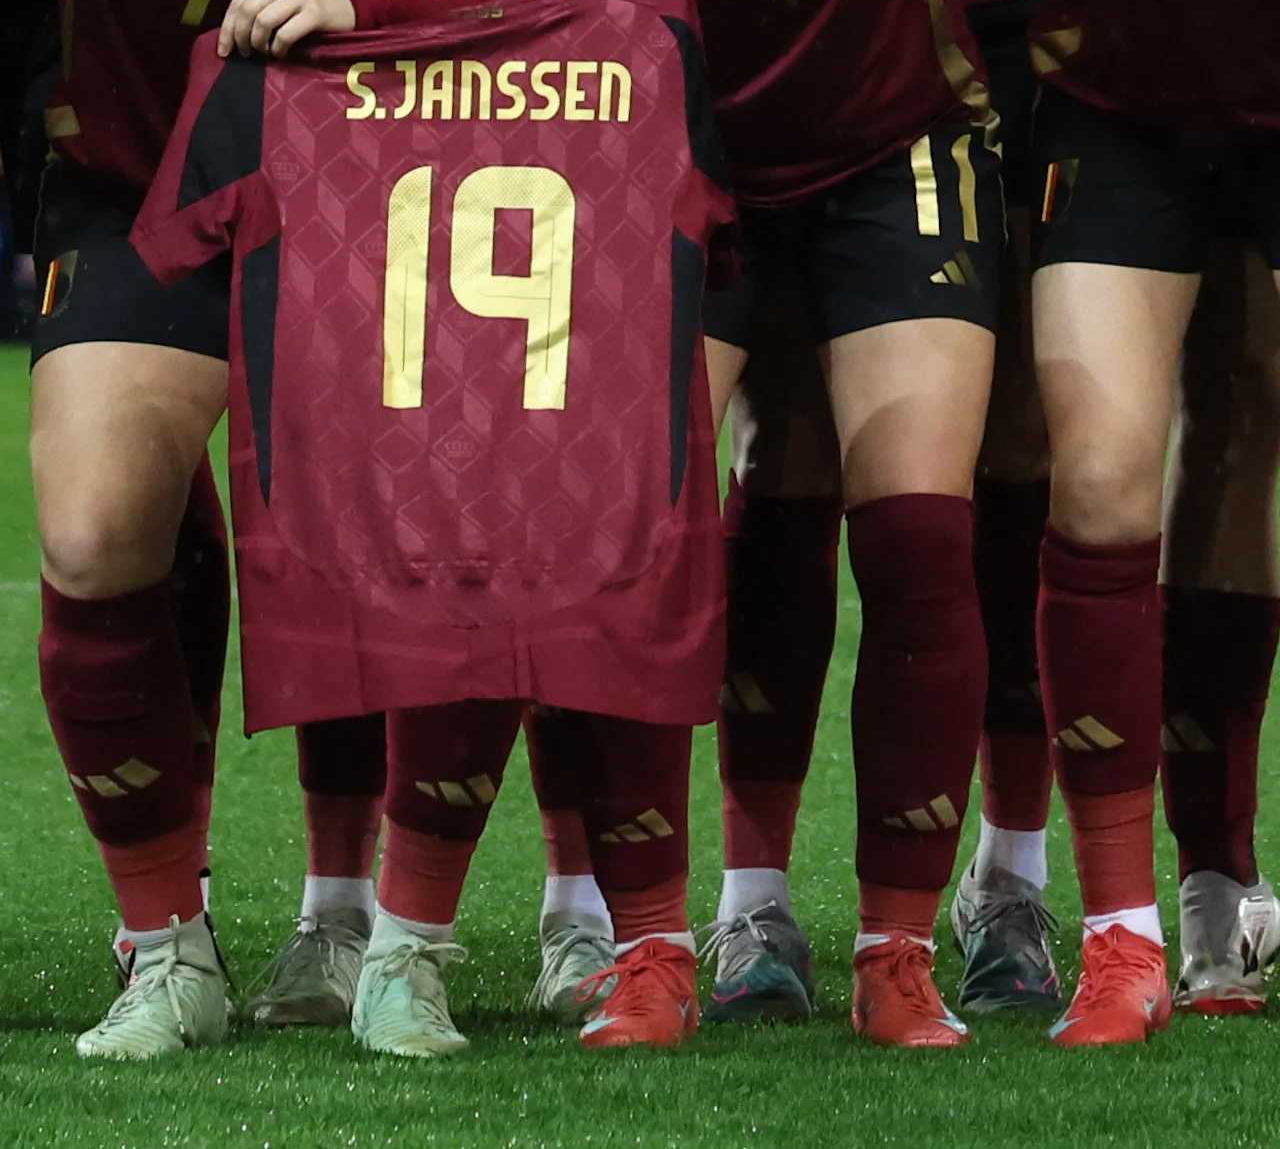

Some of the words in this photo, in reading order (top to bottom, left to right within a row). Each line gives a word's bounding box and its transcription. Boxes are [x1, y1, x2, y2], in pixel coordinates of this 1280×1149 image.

[345, 60, 632, 122] S.JANSSEN
[910, 134, 979, 243] 11
[382, 165, 576, 411] 19
